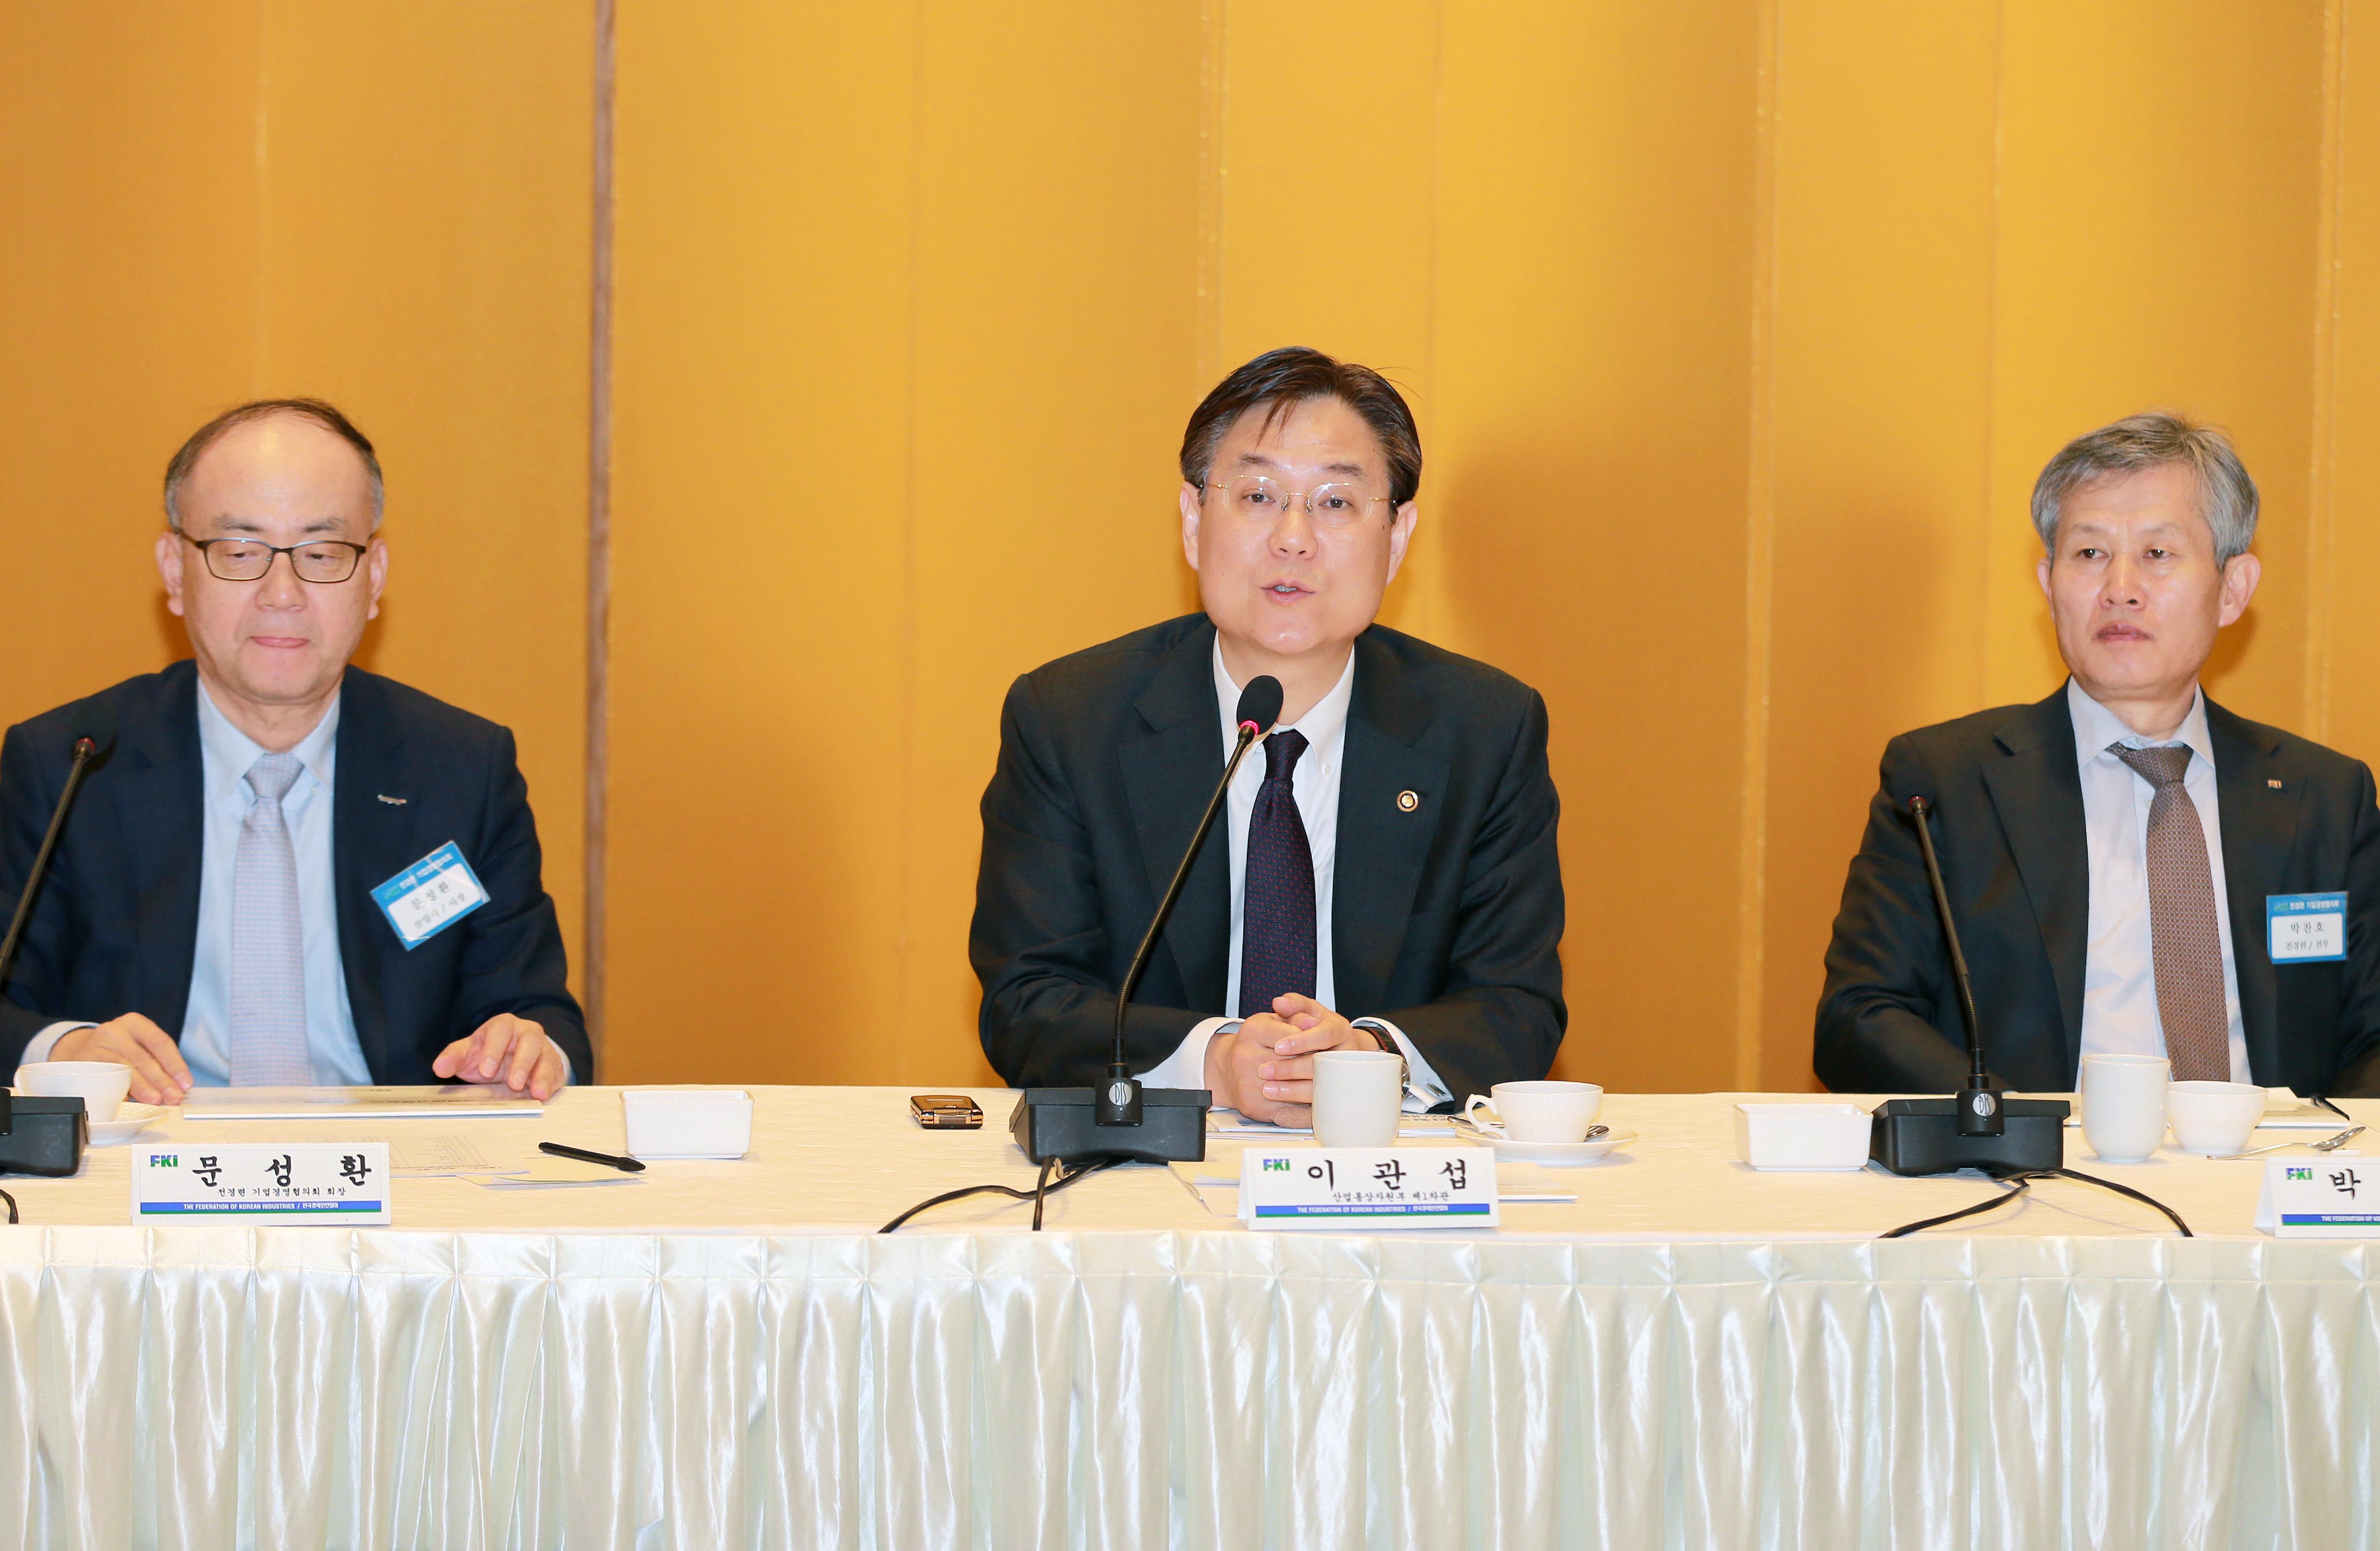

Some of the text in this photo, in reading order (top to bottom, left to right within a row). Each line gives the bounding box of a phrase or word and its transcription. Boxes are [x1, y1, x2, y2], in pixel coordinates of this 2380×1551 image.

[150, 1155, 178, 1167] FKI
[1263, 1159, 1290, 1171] FKI
[192, 1154, 372, 1187] 문 성 환
[1308, 1158, 1466, 1191] 이 관 섭
[2285, 1167, 2312, 1180] FKI
[2328, 1169, 2361, 1200] 박
[218, 1188, 245, 1197] 전경련
[327, 1187, 346, 1196] 회장
